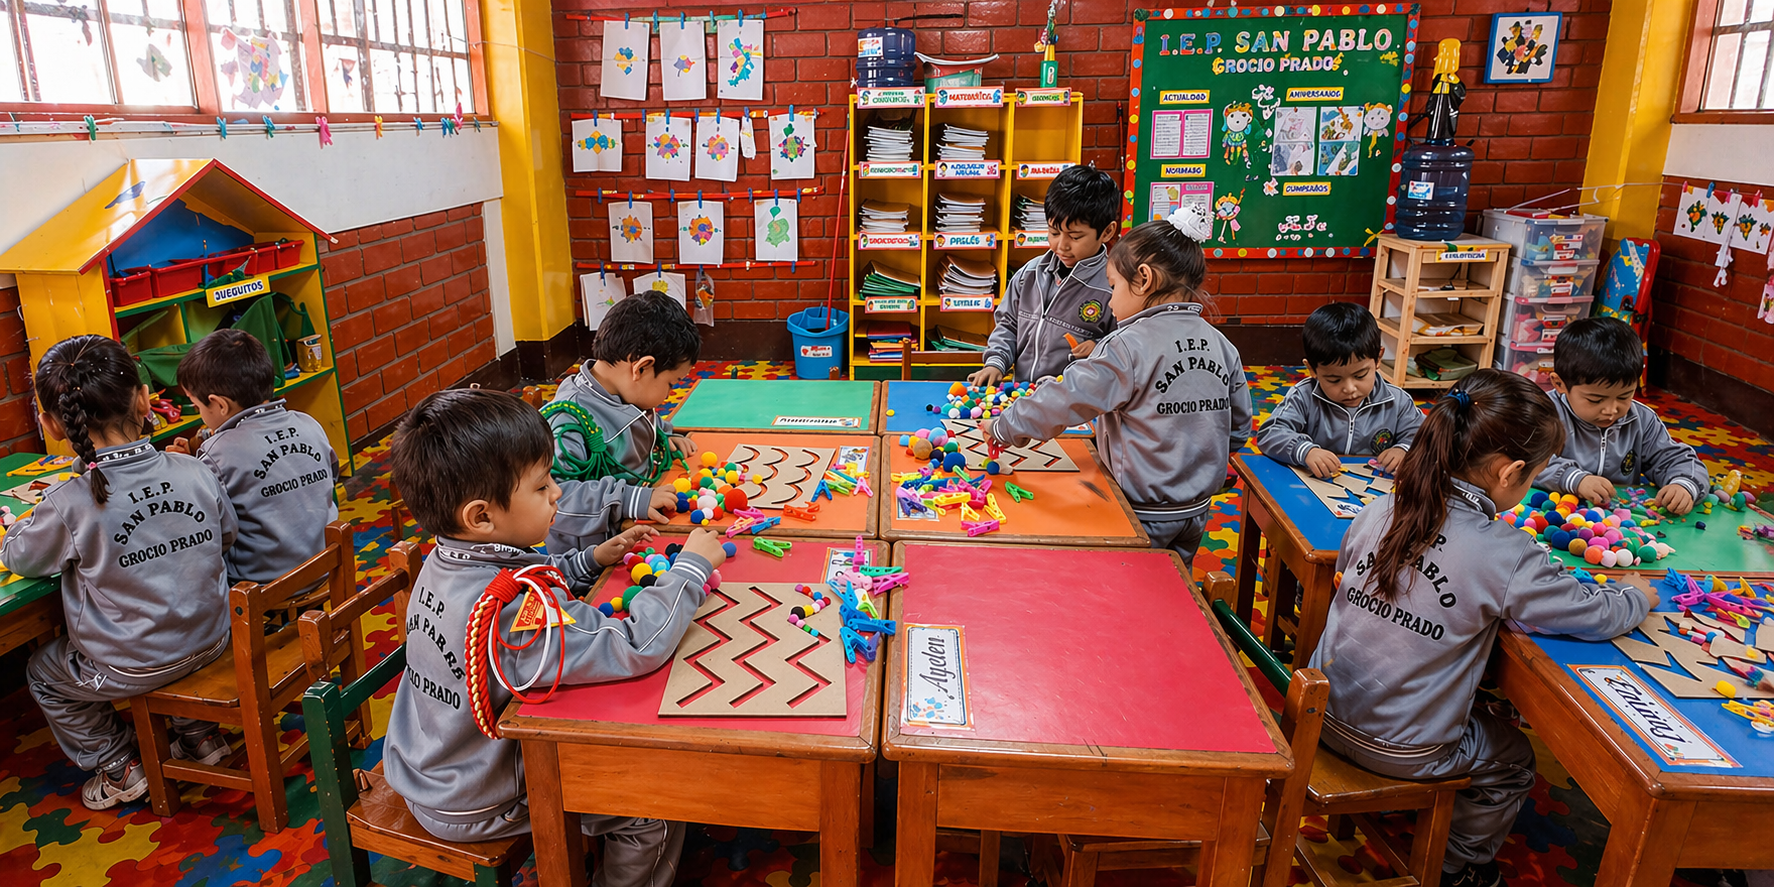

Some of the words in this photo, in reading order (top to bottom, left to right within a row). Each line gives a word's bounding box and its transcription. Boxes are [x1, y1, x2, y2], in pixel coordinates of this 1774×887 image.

[1160, 32, 1223, 55] I.E.P.
[1235, 30, 1290, 54] SAN
[1302, 28, 1393, 52] PABLO
[1212, 56, 1275, 75] GROCIO
[1279, 56, 1334, 72] PRADO
[1175, 338, 1210, 353] I.E.P.
[1155, 360, 1185, 393] SAN
[1187, 356, 1229, 386] PABLO
[1157, 401, 1197, 414] GROCIO
[264, 427, 299, 444] I.E.P.
[254, 449, 279, 480] SAN
[280, 443, 321, 462] PABLO
[128, 481, 174, 504] I.E.P.
[261, 479, 298, 498] GROCIO
[300, 469, 328, 487] PRADO
[114, 510, 145, 545] SAN
[147, 500, 205, 523] PABLO
[119, 543, 167, 567] GROCIO
[169, 529, 213, 553] PRADO
[418, 586, 446, 619] I.E.P.
[1347, 587, 1392, 618] GROCIO
[1391, 607, 1445, 640] PRADO
[423, 677, 461, 710] PRADO
